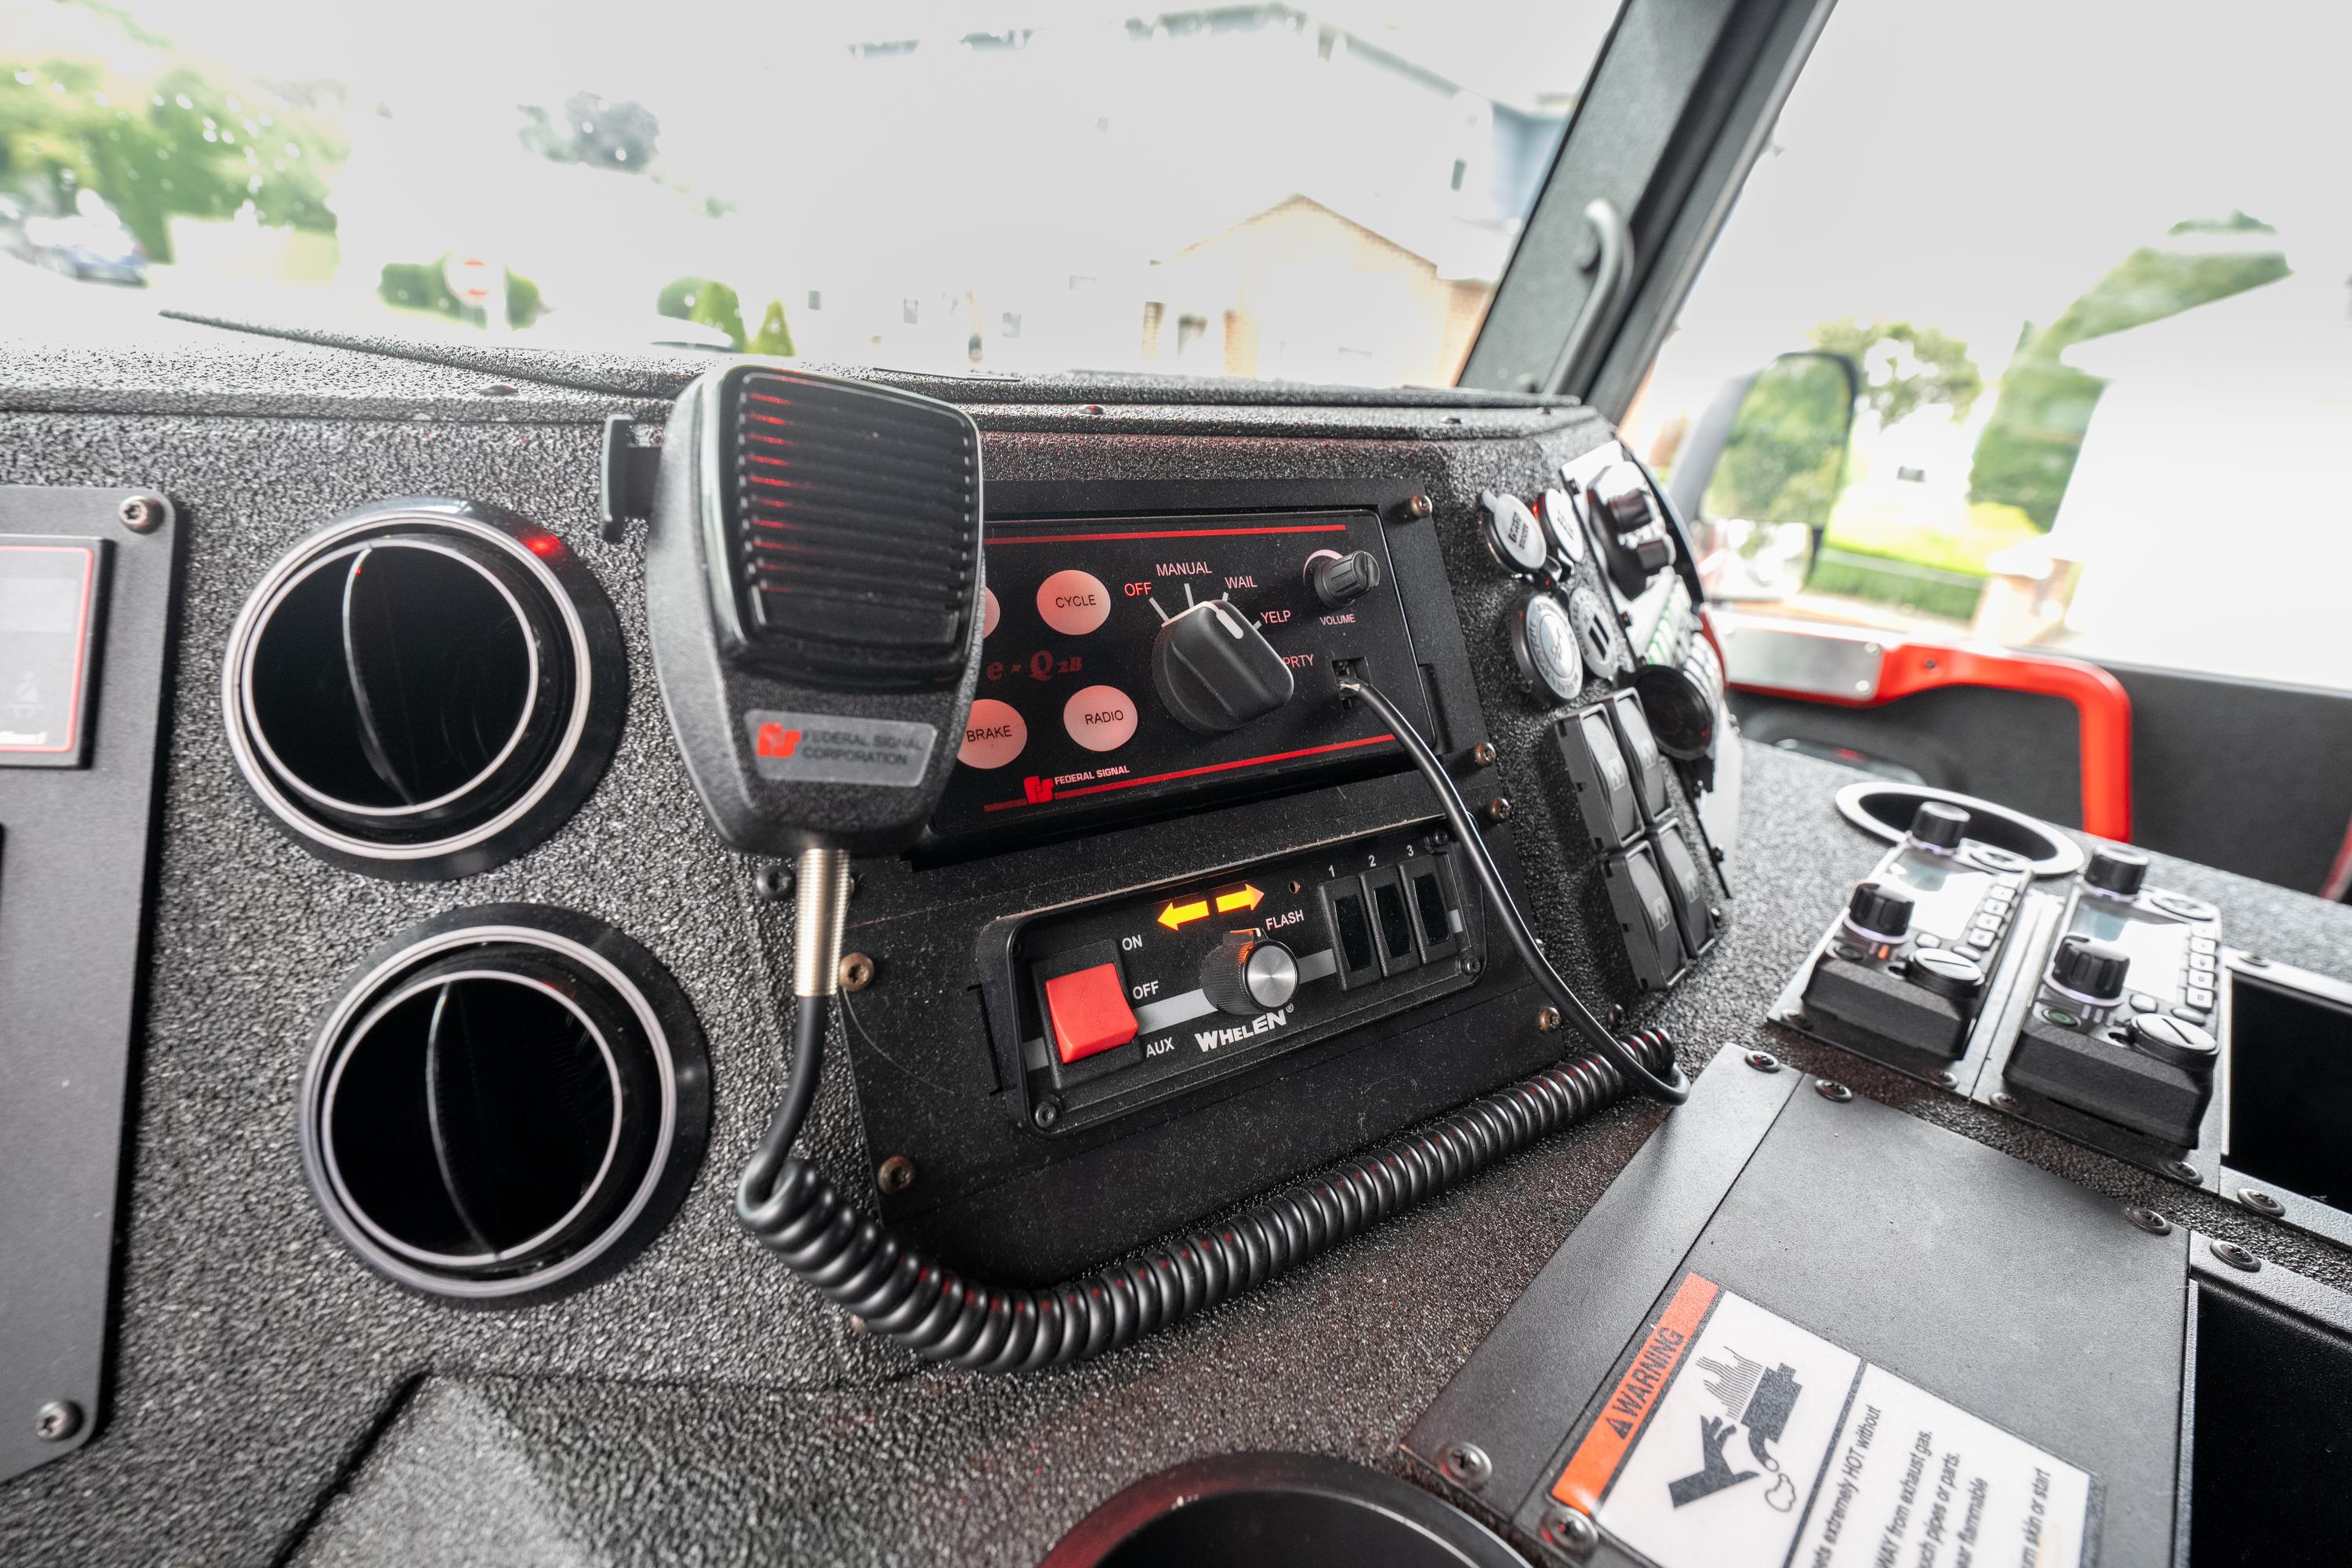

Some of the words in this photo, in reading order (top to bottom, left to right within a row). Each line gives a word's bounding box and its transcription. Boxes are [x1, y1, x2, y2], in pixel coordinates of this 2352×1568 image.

[1156, 561, 1212, 577] MANUAL
[1123, 582, 1152, 597] OFF
[1225, 575, 1258, 590] WAIL
[1055, 593, 1097, 608] CYCLE
[1261, 610, 1291, 624] YELP
[1319, 613, 1356, 626] VOLUME
[1283, 654, 1314, 667] PRTY
[1084, 709, 1124, 725] RADIO
[966, 725, 1012, 742] BRAKE
[802, 746, 908, 764] CORPORATION
[1054, 771, 1095, 785] FEDERAL
[1096, 765, 1130, 779] SIGNAL
[1328, 865, 1335, 877] 1
[1368, 855, 1377, 867] 2
[1406, 844, 1414, 857] 3
[1265, 909, 1305, 931] FLASH
[1122, 935, 1142, 951] ON
[1132, 981, 1160, 1000] OFF
[1145, 1036, 1174, 1058] AUX
[1612, 1327, 1684, 1417] WARNING
[1823, 1479, 1860, 1544] extremely
[1842, 1446, 1865, 1480] HOT
[1856, 1403, 1882, 1450] without
[1940, 1453, 1960, 1490] parts.
[1886, 1504, 1910, 1537] from
[1900, 1451, 1926, 1504] exhaust
[1915, 1430, 1933, 1456] gas.
[2033, 1467, 2051, 1500] start
[1936, 1485, 1950, 1501] or
[1957, 1477, 1988, 1546] flammable
[2031, 1499, 2045, 1515] or
[1925, 1503, 1947, 1544] pipes
[2023, 1516, 2042, 1547] skin
